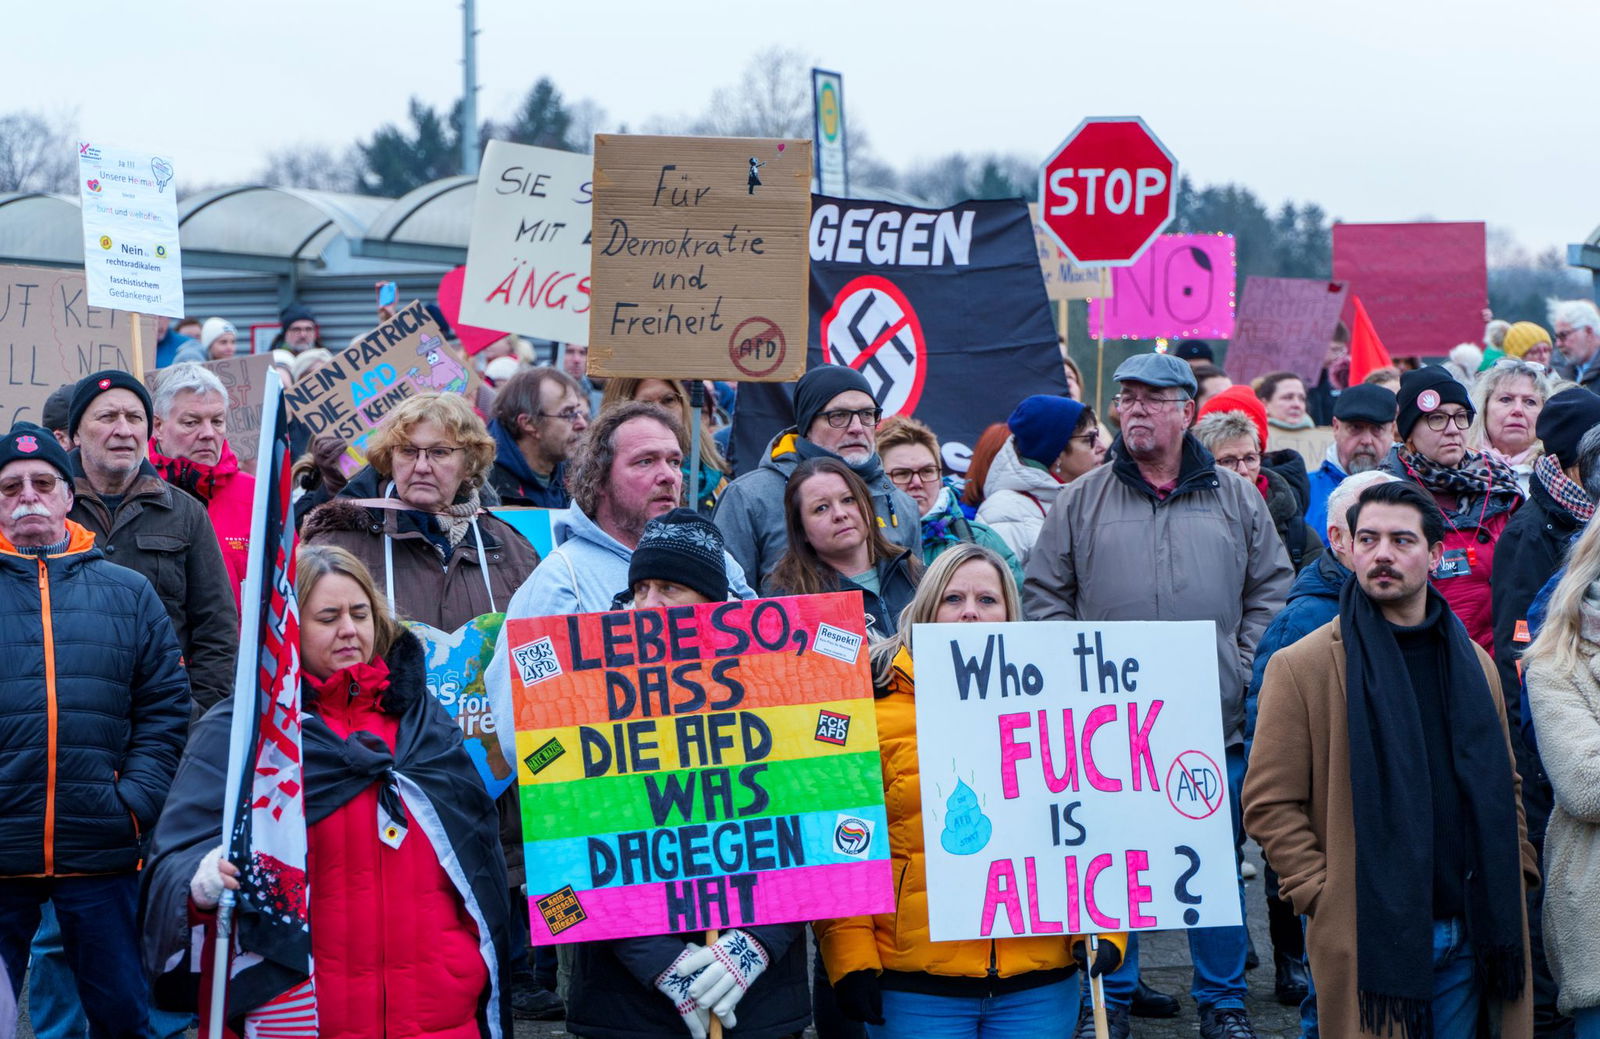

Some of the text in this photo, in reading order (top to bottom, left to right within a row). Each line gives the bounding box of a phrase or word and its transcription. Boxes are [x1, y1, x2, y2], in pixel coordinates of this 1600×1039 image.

[99, 171, 127, 183] Unsere
[495, 166, 551, 198] SIE
[652, 164, 711, 208] Für
[1049, 167, 1168, 216] STOP
[121, 244, 143, 256] Nein
[515, 217, 566, 244] MIT
[600, 218, 766, 260] Demokratie
[808, 203, 976, 266] GEGEN
[106, 257, 161, 272] rechtsradikalem
[110, 275, 160, 290] faschistischem
[652, 264, 708, 291] und
[108, 287, 162, 304] Gedankengut!
[610, 296, 723, 336] Freiheit
[284, 302, 431, 412] NEIN PATRICK
[303, 392, 350, 435] DIE
[333, 381, 415, 441] IST KEINE
[515, 642, 553, 667] FCK
[566, 601, 809, 671] LEBE SO,
[821, 628, 858, 647] Respekt!
[524, 658, 558, 682] AFD
[950, 631, 1140, 700] Who the
[605, 658, 745, 721] DASS
[817, 725, 846, 740] AFD
[819, 714, 849, 731] FCK
[579, 710, 773, 779] DIE AFD
[998, 699, 1164, 800] FUCK
[644, 763, 770, 826] WAS
[1176, 768, 1218, 802] AFD
[1049, 801, 1087, 847] IS
[587, 815, 806, 888] DAGEGEN
[543, 896, 577, 918] mensch
[547, 892, 565, 906] kein
[664, 873, 758, 932] HAT
[980, 845, 1203, 937] ALICE ?
